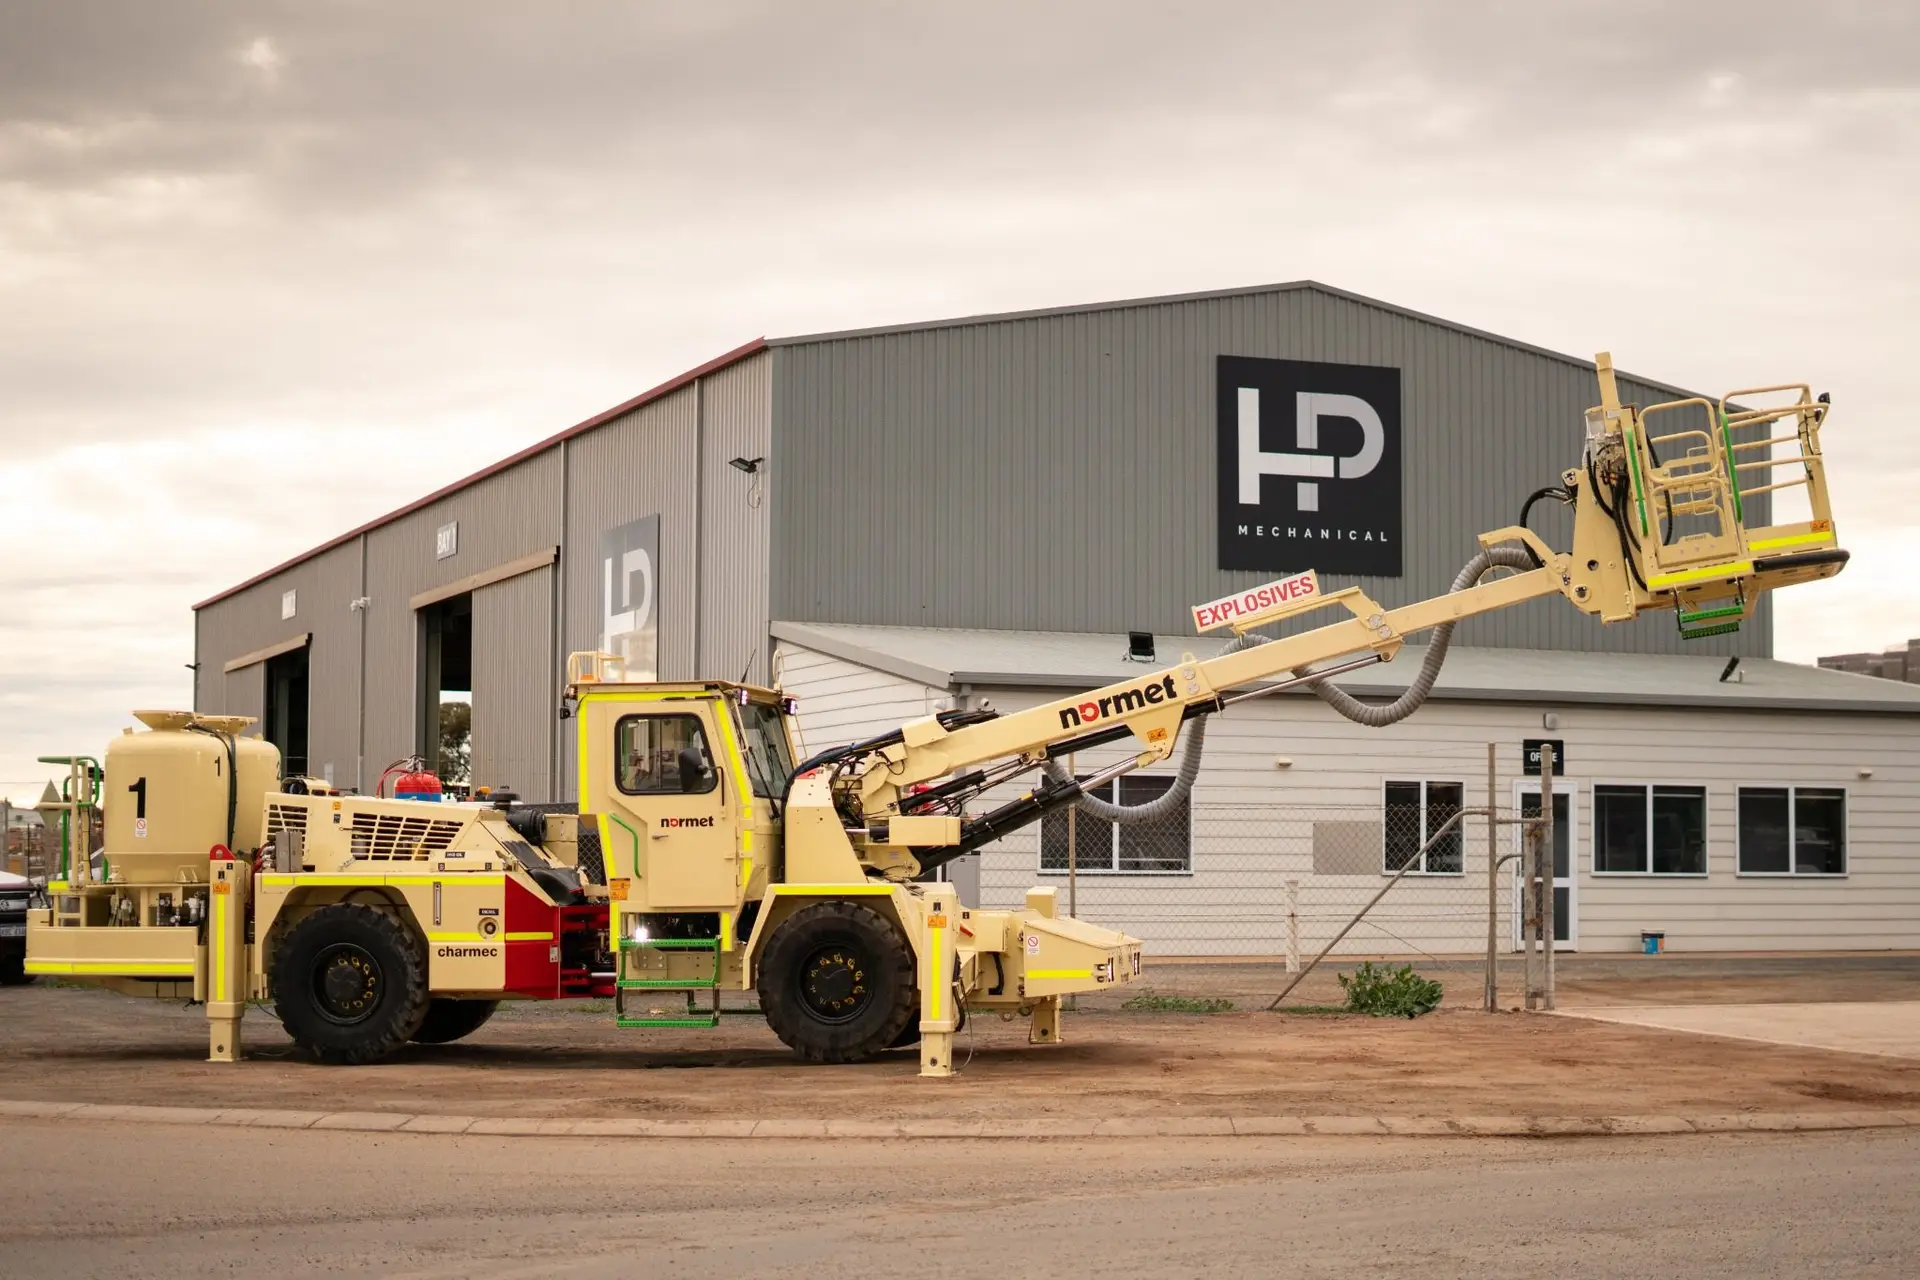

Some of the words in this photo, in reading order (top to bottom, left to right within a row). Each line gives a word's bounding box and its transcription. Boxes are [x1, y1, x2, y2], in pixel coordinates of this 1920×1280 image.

[1238, 524, 1388, 542] MECHANICAL
[1195, 575, 1314, 628] EXPLOSIVES
[1058, 674, 1178, 730] normet
[214, 756, 220, 777] 1
[1530, 752, 1558, 762] OFE
[128, 777, 146, 818] 1
[660, 815, 714, 828] normet
[437, 946, 498, 957] charmec
